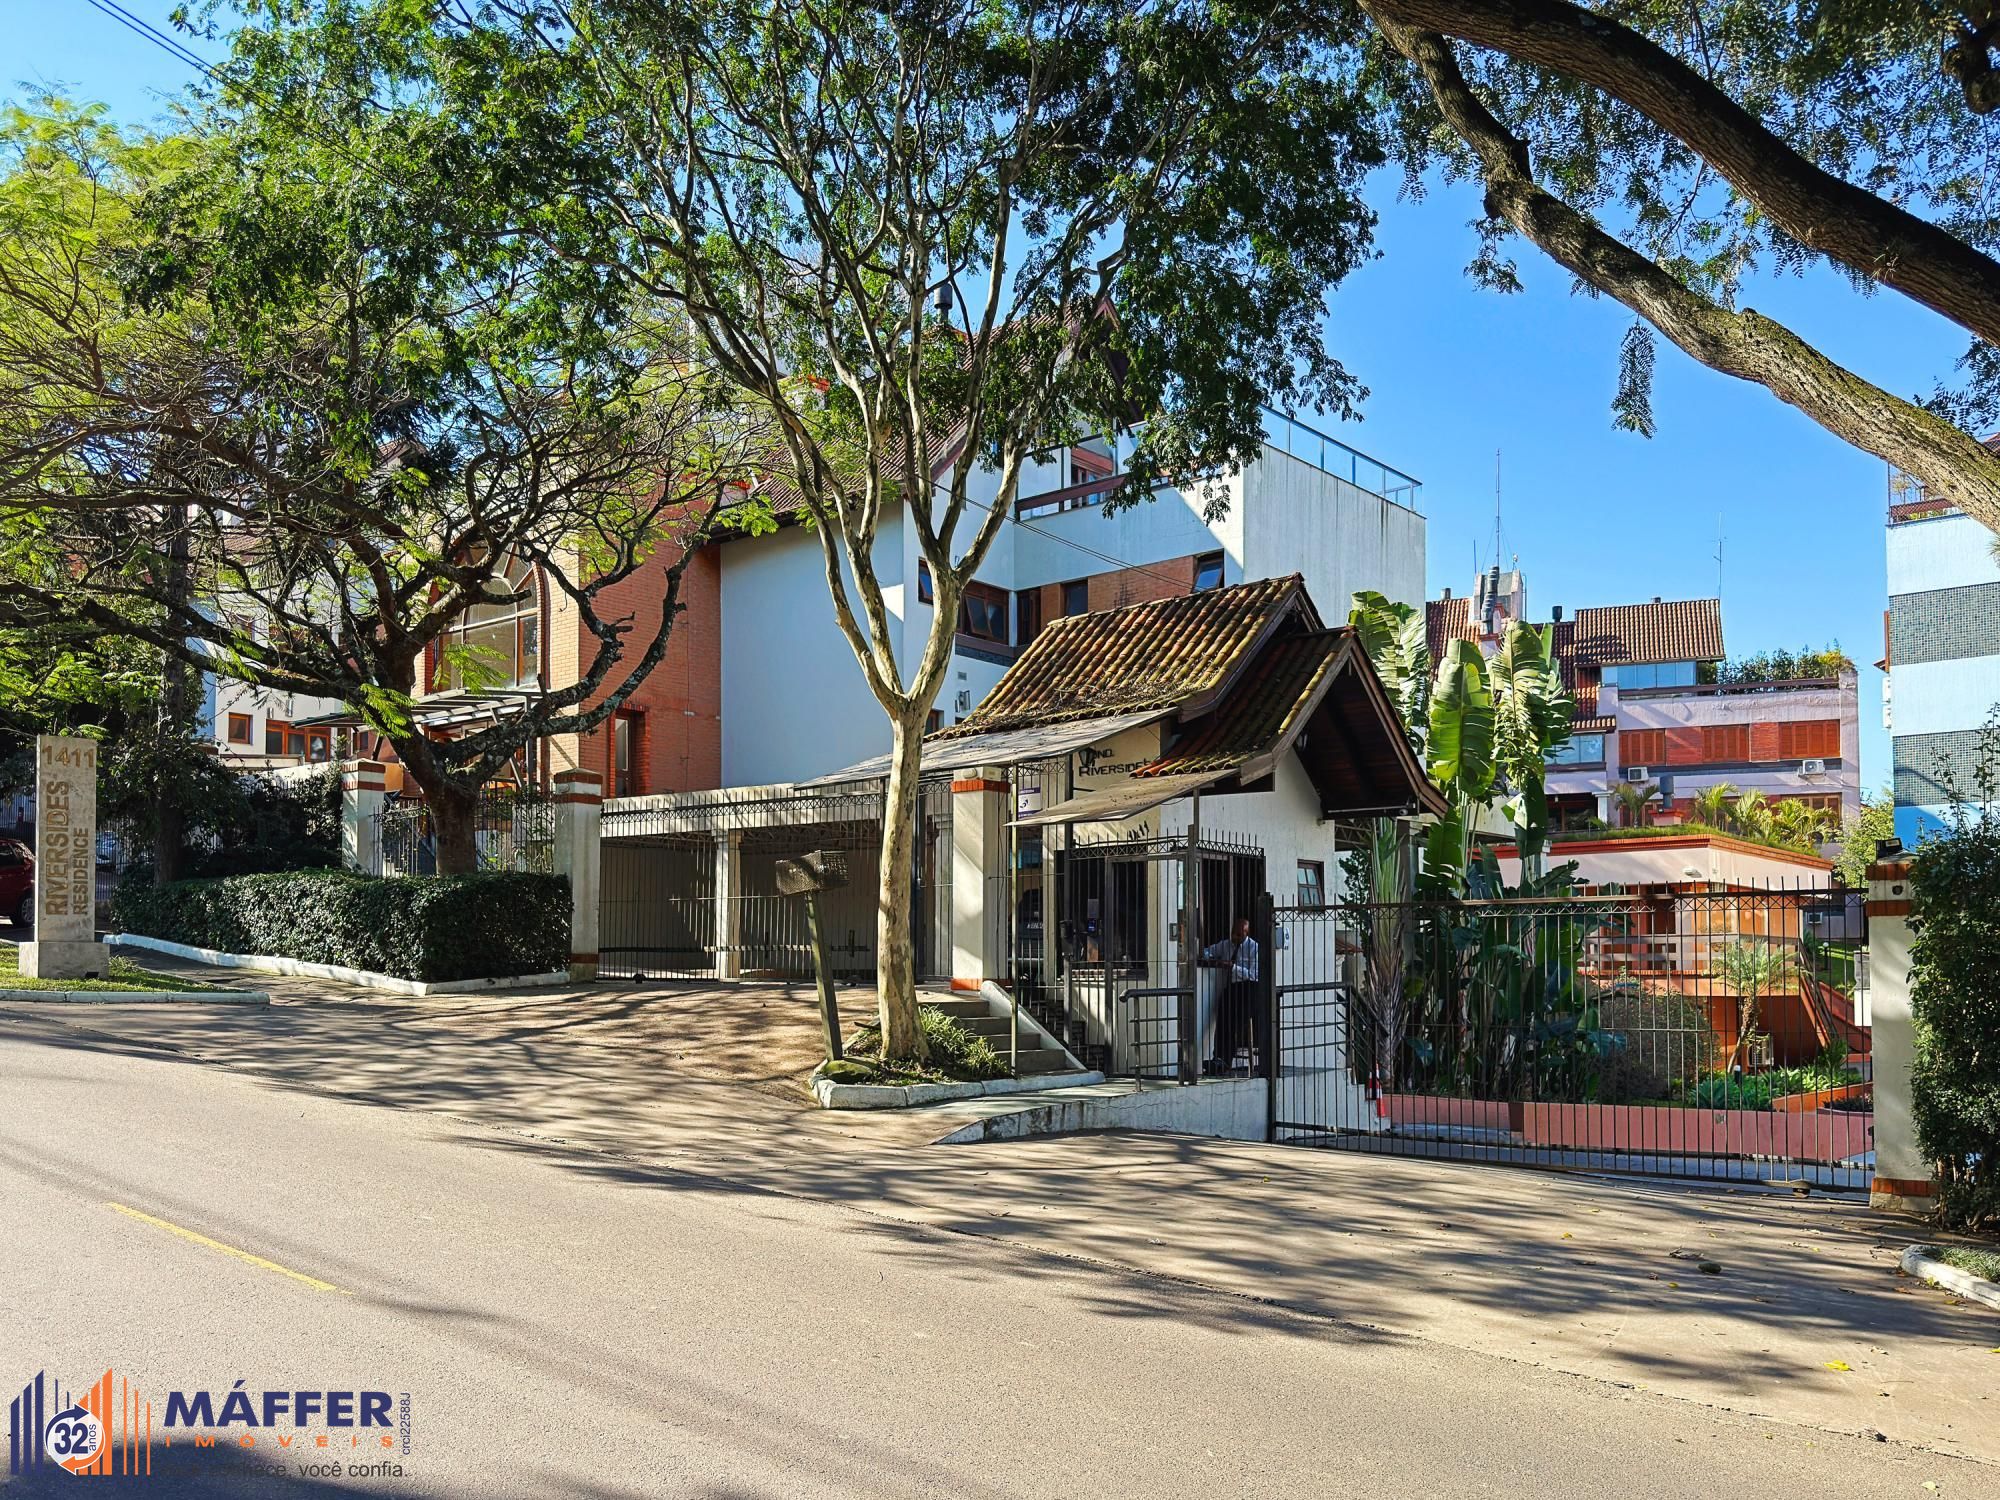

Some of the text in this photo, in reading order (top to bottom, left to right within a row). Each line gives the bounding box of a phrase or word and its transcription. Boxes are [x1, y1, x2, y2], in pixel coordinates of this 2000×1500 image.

[42, 745, 94, 768] 1411
[46, 780, 69, 916] RIVERSIDES
[73, 827, 89, 915] RESIDENCE
